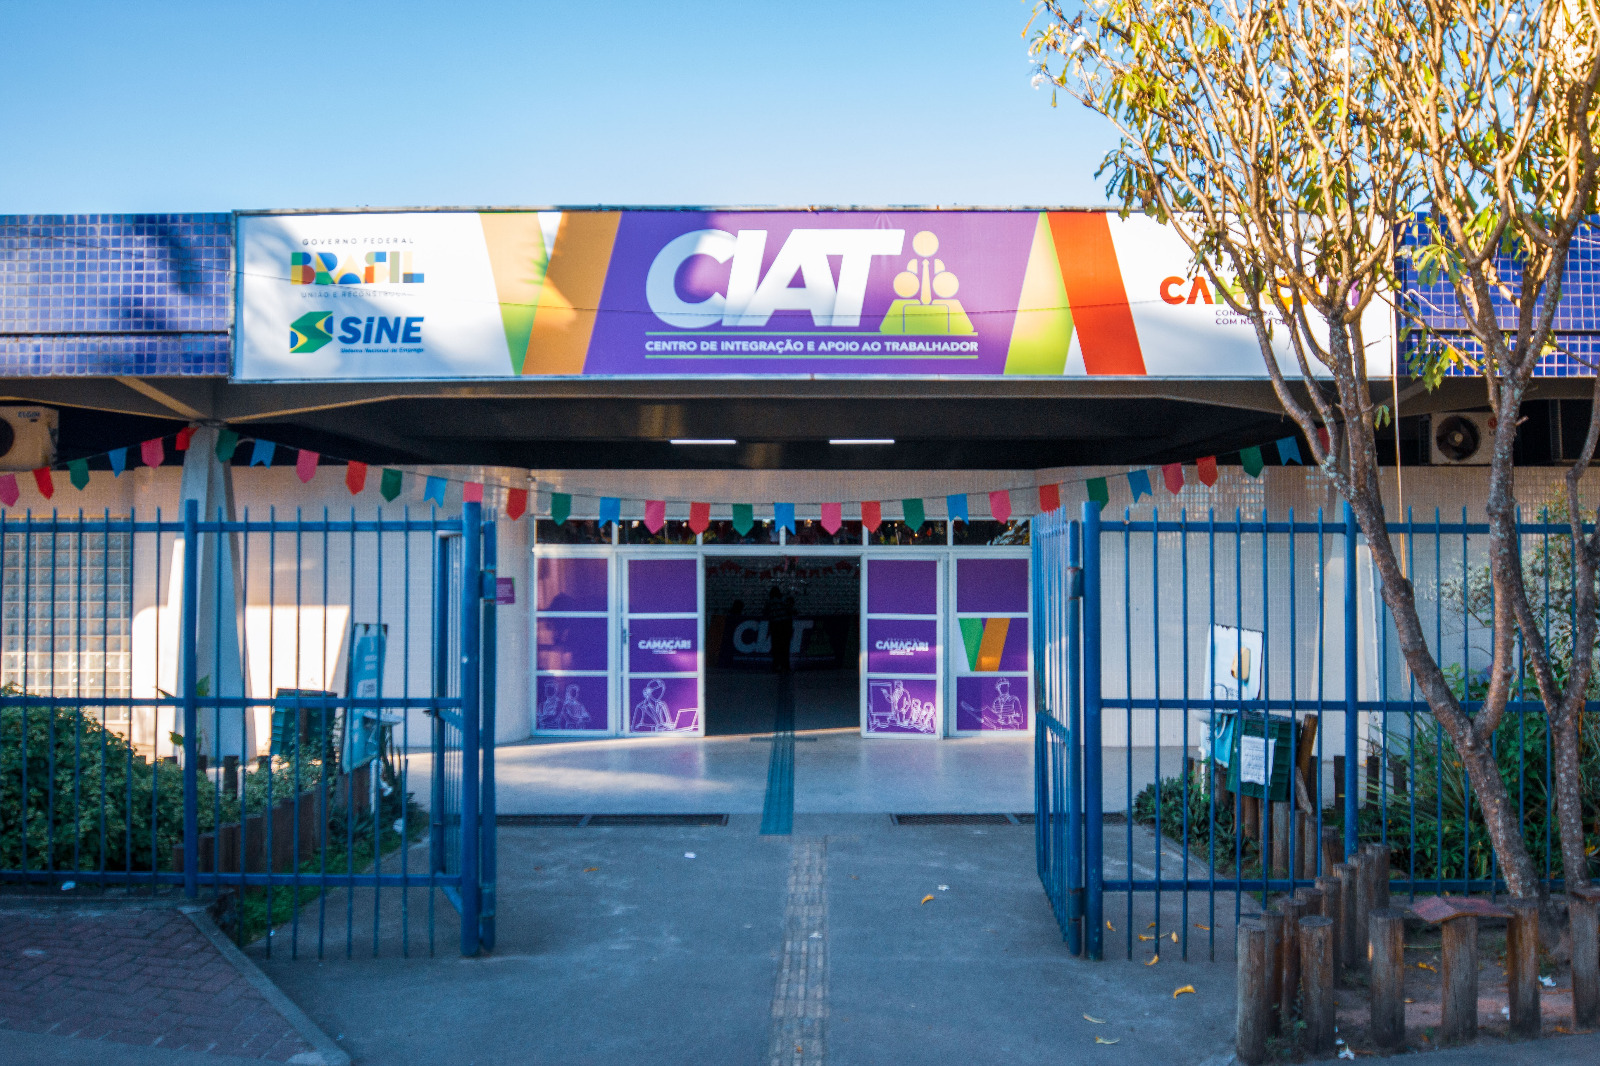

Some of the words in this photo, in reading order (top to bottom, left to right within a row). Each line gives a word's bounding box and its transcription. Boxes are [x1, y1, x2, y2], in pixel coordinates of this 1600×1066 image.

[302, 238, 357, 246] GOVERNO
[363, 237, 414, 245] FEDERAL
[290, 251, 425, 285] BRASIL
[645, 228, 906, 329] CIAT
[645, 340, 697, 351] CENTRO
[700, 340, 718, 351] DE
[720, 339, 804, 353] INTEGRAÇÃO
[806, 341, 815, 351] E
[818, 341, 860, 351] APOIO
[861, 341, 882, 351] AO
[884, 341, 979, 351] TRABALHADOR
[733, 620, 815, 654] CIT
